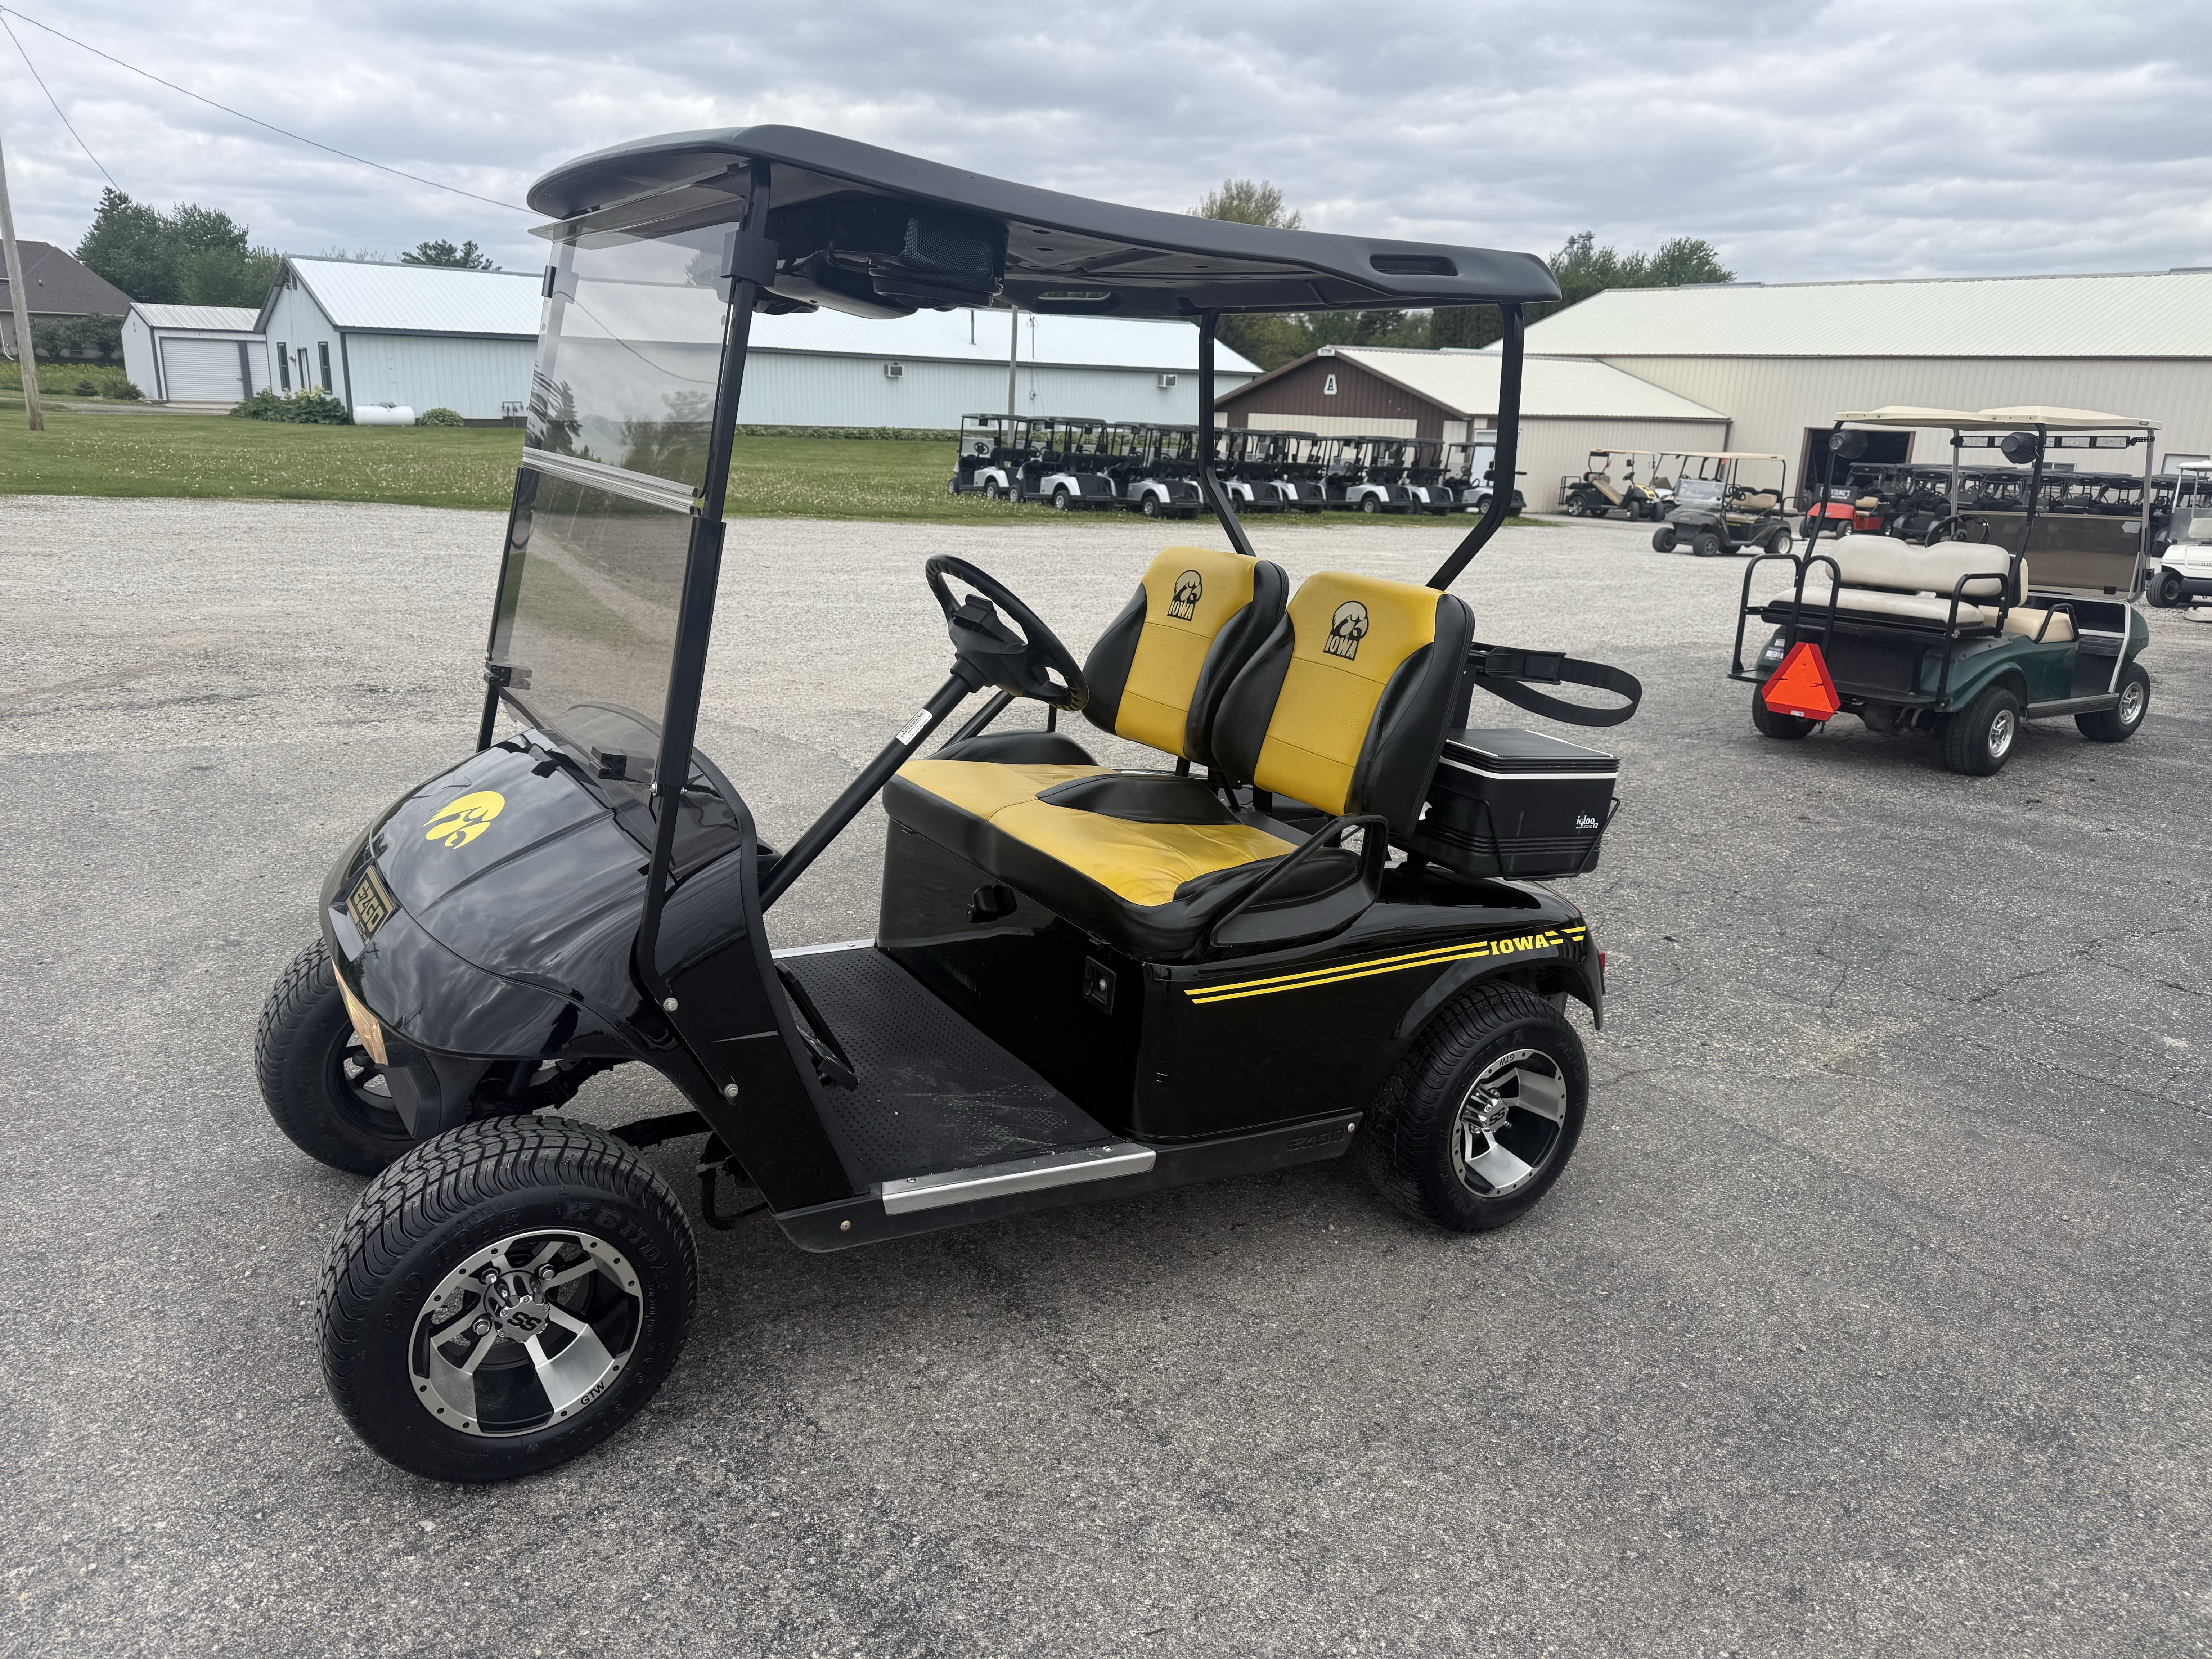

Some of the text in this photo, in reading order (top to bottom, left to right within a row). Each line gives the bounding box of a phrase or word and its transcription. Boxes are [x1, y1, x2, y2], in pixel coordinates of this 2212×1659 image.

[1327, 377, 1334, 391] A
[1168, 600, 1194, 620] IOWA
[1324, 634, 1358, 658] IOWA
[1577, 815, 1595, 827] igloo
[1490, 934, 1550, 956] IOWA
[1499, 1053, 1514, 1067] GTW
[1489, 1107, 1505, 1126] SS
[380, 1206, 522, 1335] PRO TOUR
[507, 1311, 542, 1331] SS
[581, 1380, 604, 1405] GTW
